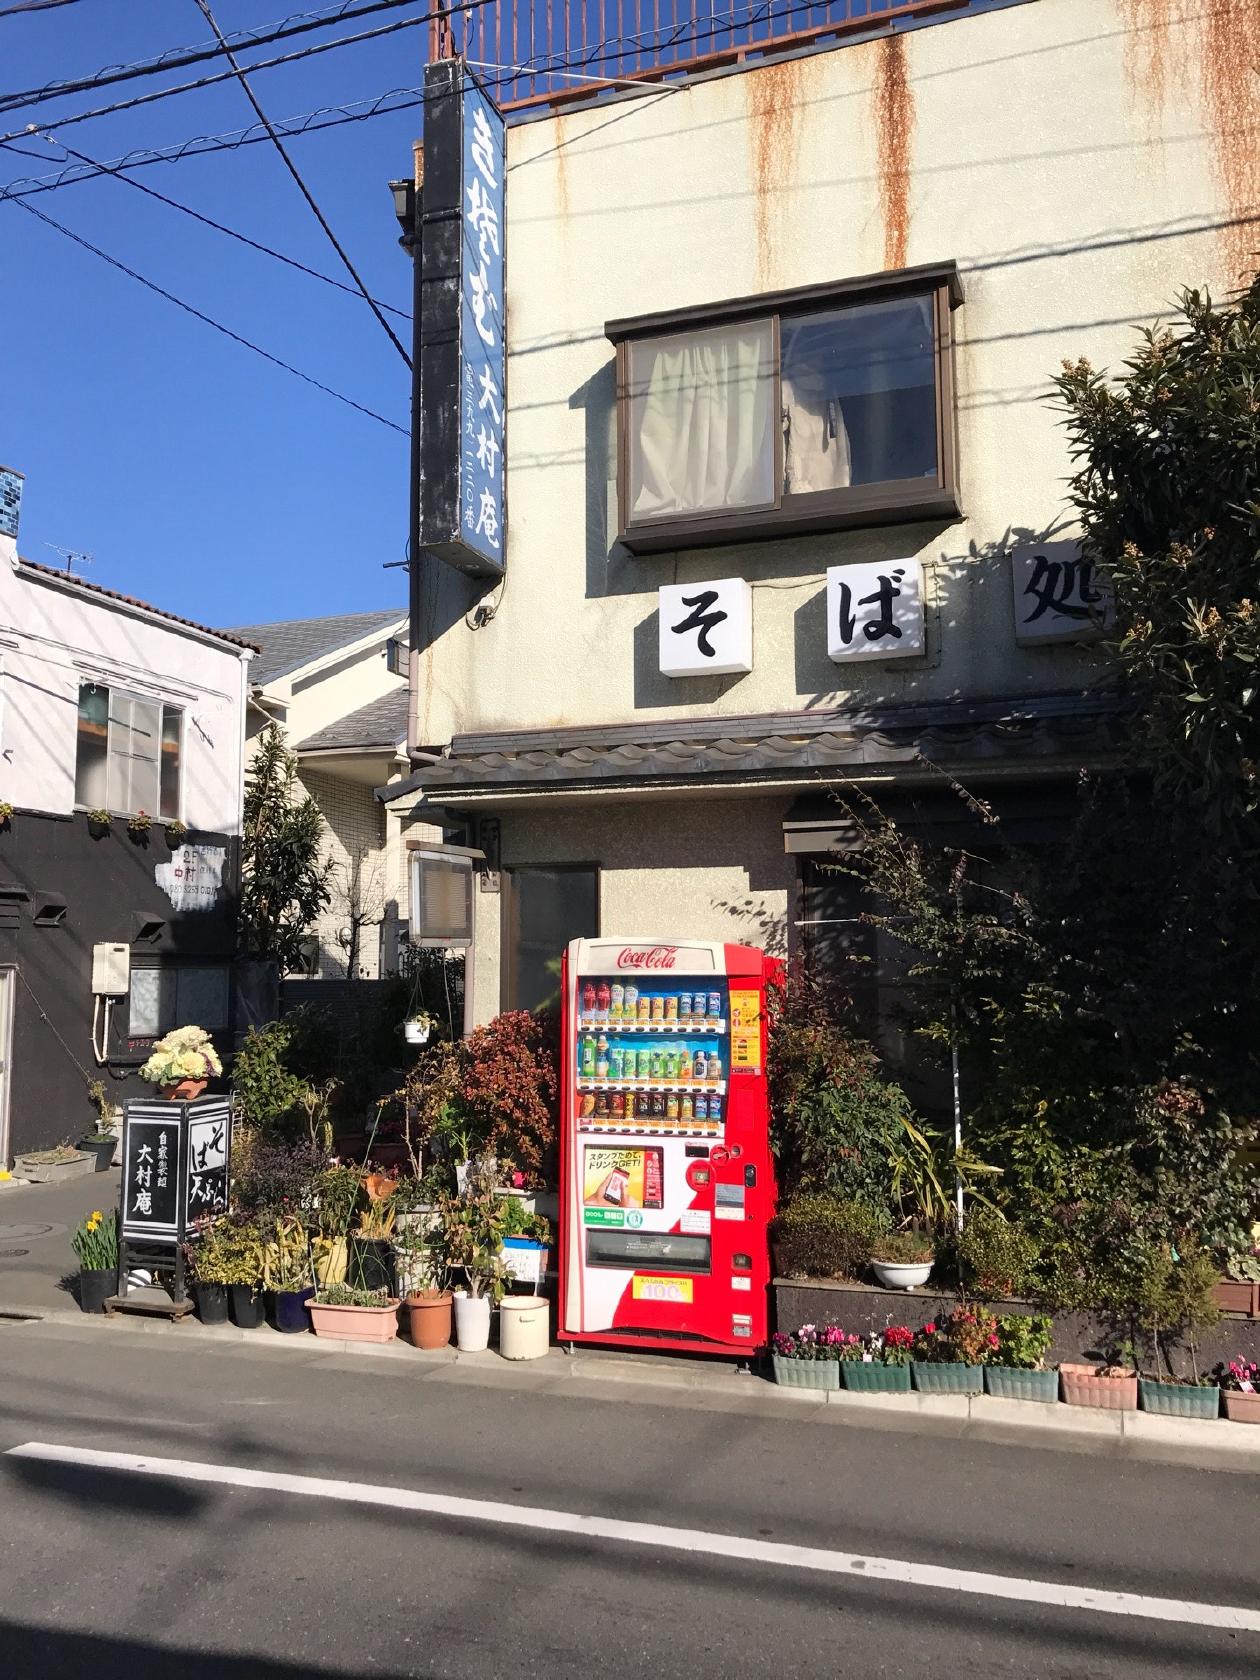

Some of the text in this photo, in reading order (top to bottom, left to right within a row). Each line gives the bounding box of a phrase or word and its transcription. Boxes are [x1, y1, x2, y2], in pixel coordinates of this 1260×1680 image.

[475, 364, 500, 548] 大村庵
[617, 947, 679, 968] Coca-Cola
[191, 1121, 225, 1172] そば
[132, 1144, 154, 1215] 大村庵
